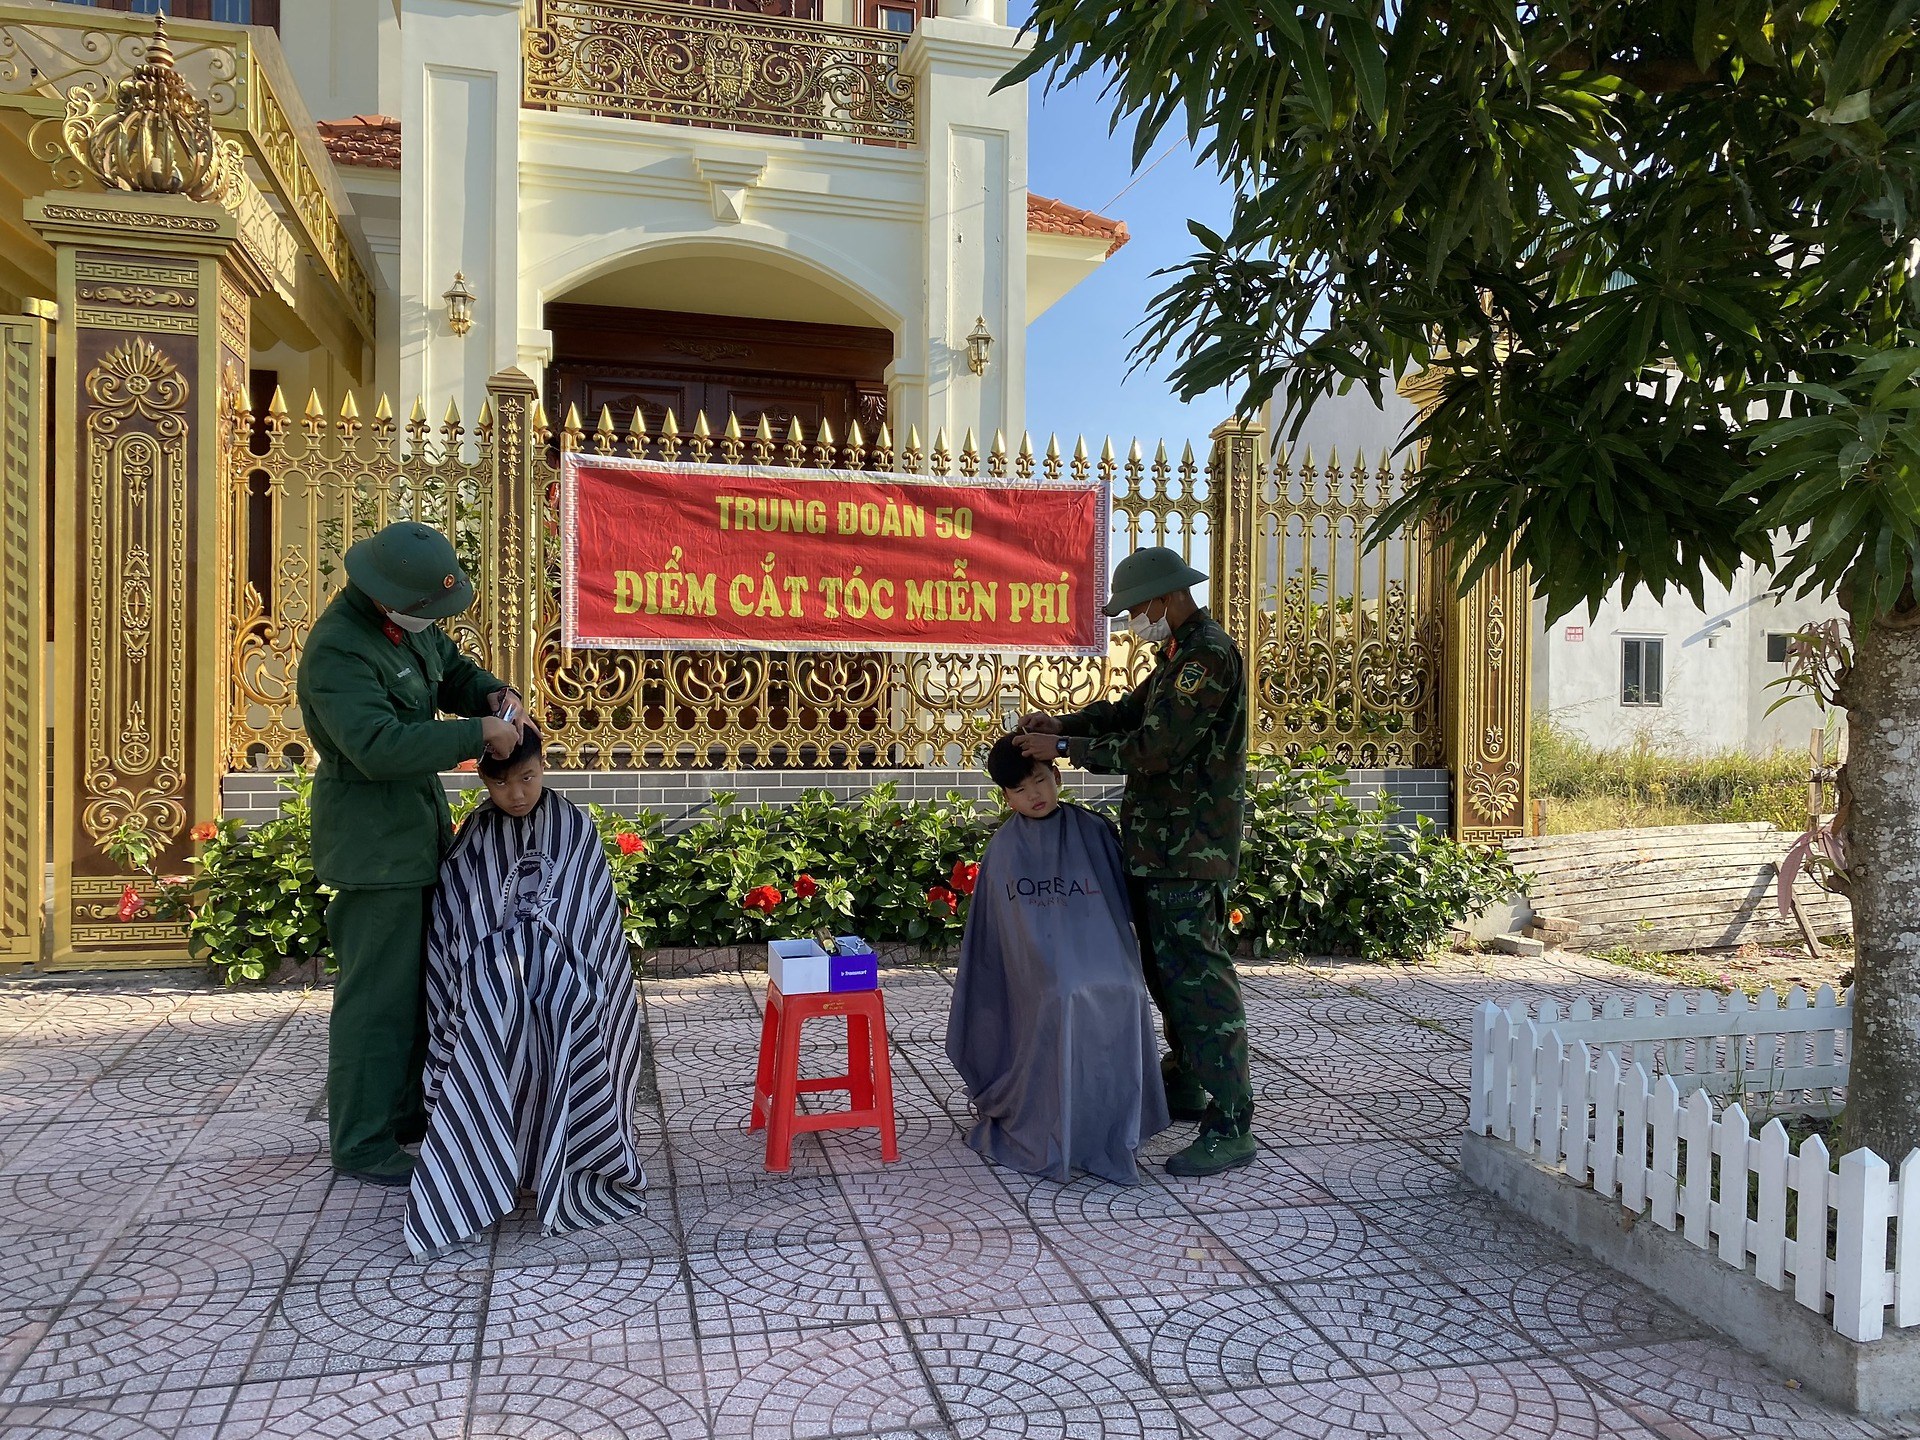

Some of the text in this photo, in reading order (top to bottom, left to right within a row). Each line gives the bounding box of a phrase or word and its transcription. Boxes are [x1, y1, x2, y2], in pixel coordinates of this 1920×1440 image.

[716, 496, 974, 540] TRUNG ĐOÀN 50
[613, 545, 1071, 624] ĐIỂM CẮT TÓC MIỄN PHÍ
[1028, 896, 1068, 908] PARIS
